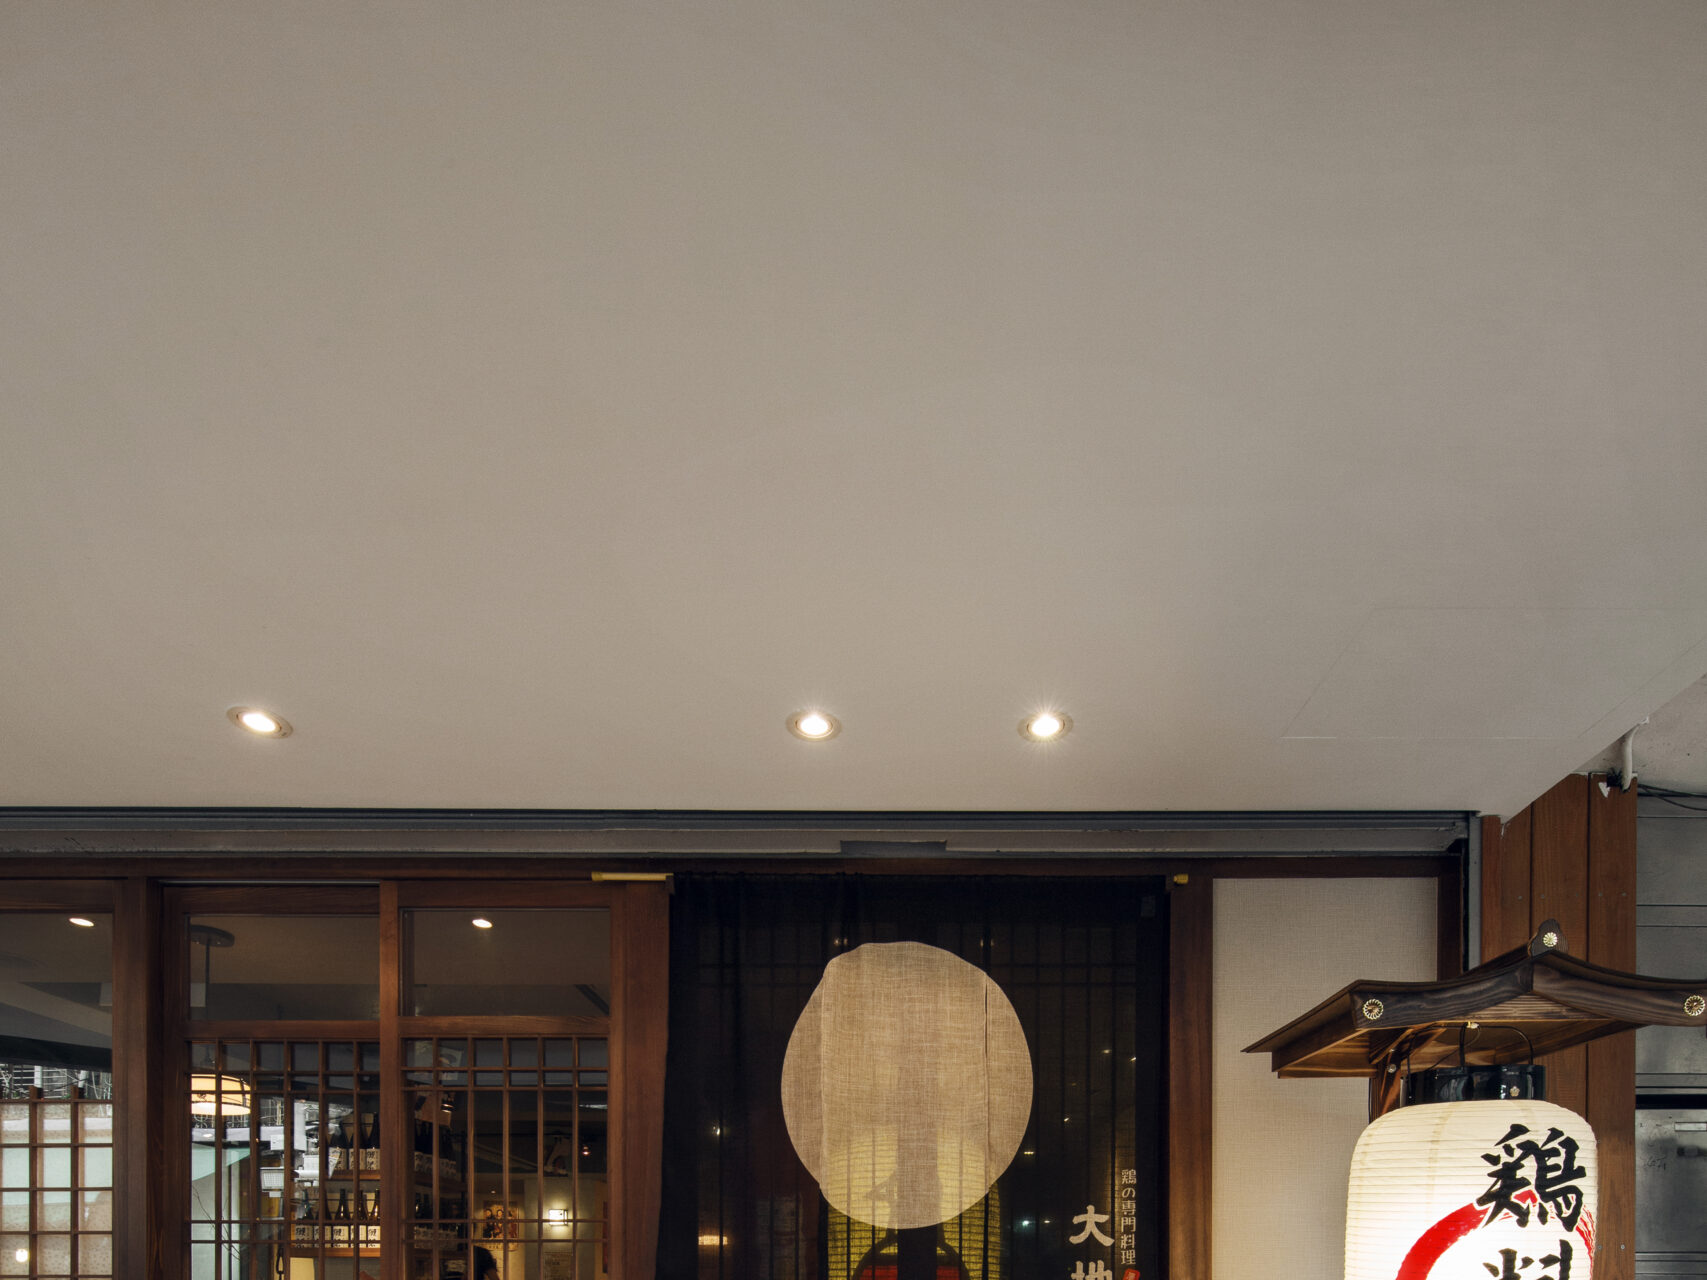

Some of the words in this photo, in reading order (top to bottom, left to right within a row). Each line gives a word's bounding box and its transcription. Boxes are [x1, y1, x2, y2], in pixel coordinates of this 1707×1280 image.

[1120, 1168, 1137, 1265] 鶏の専門料理
